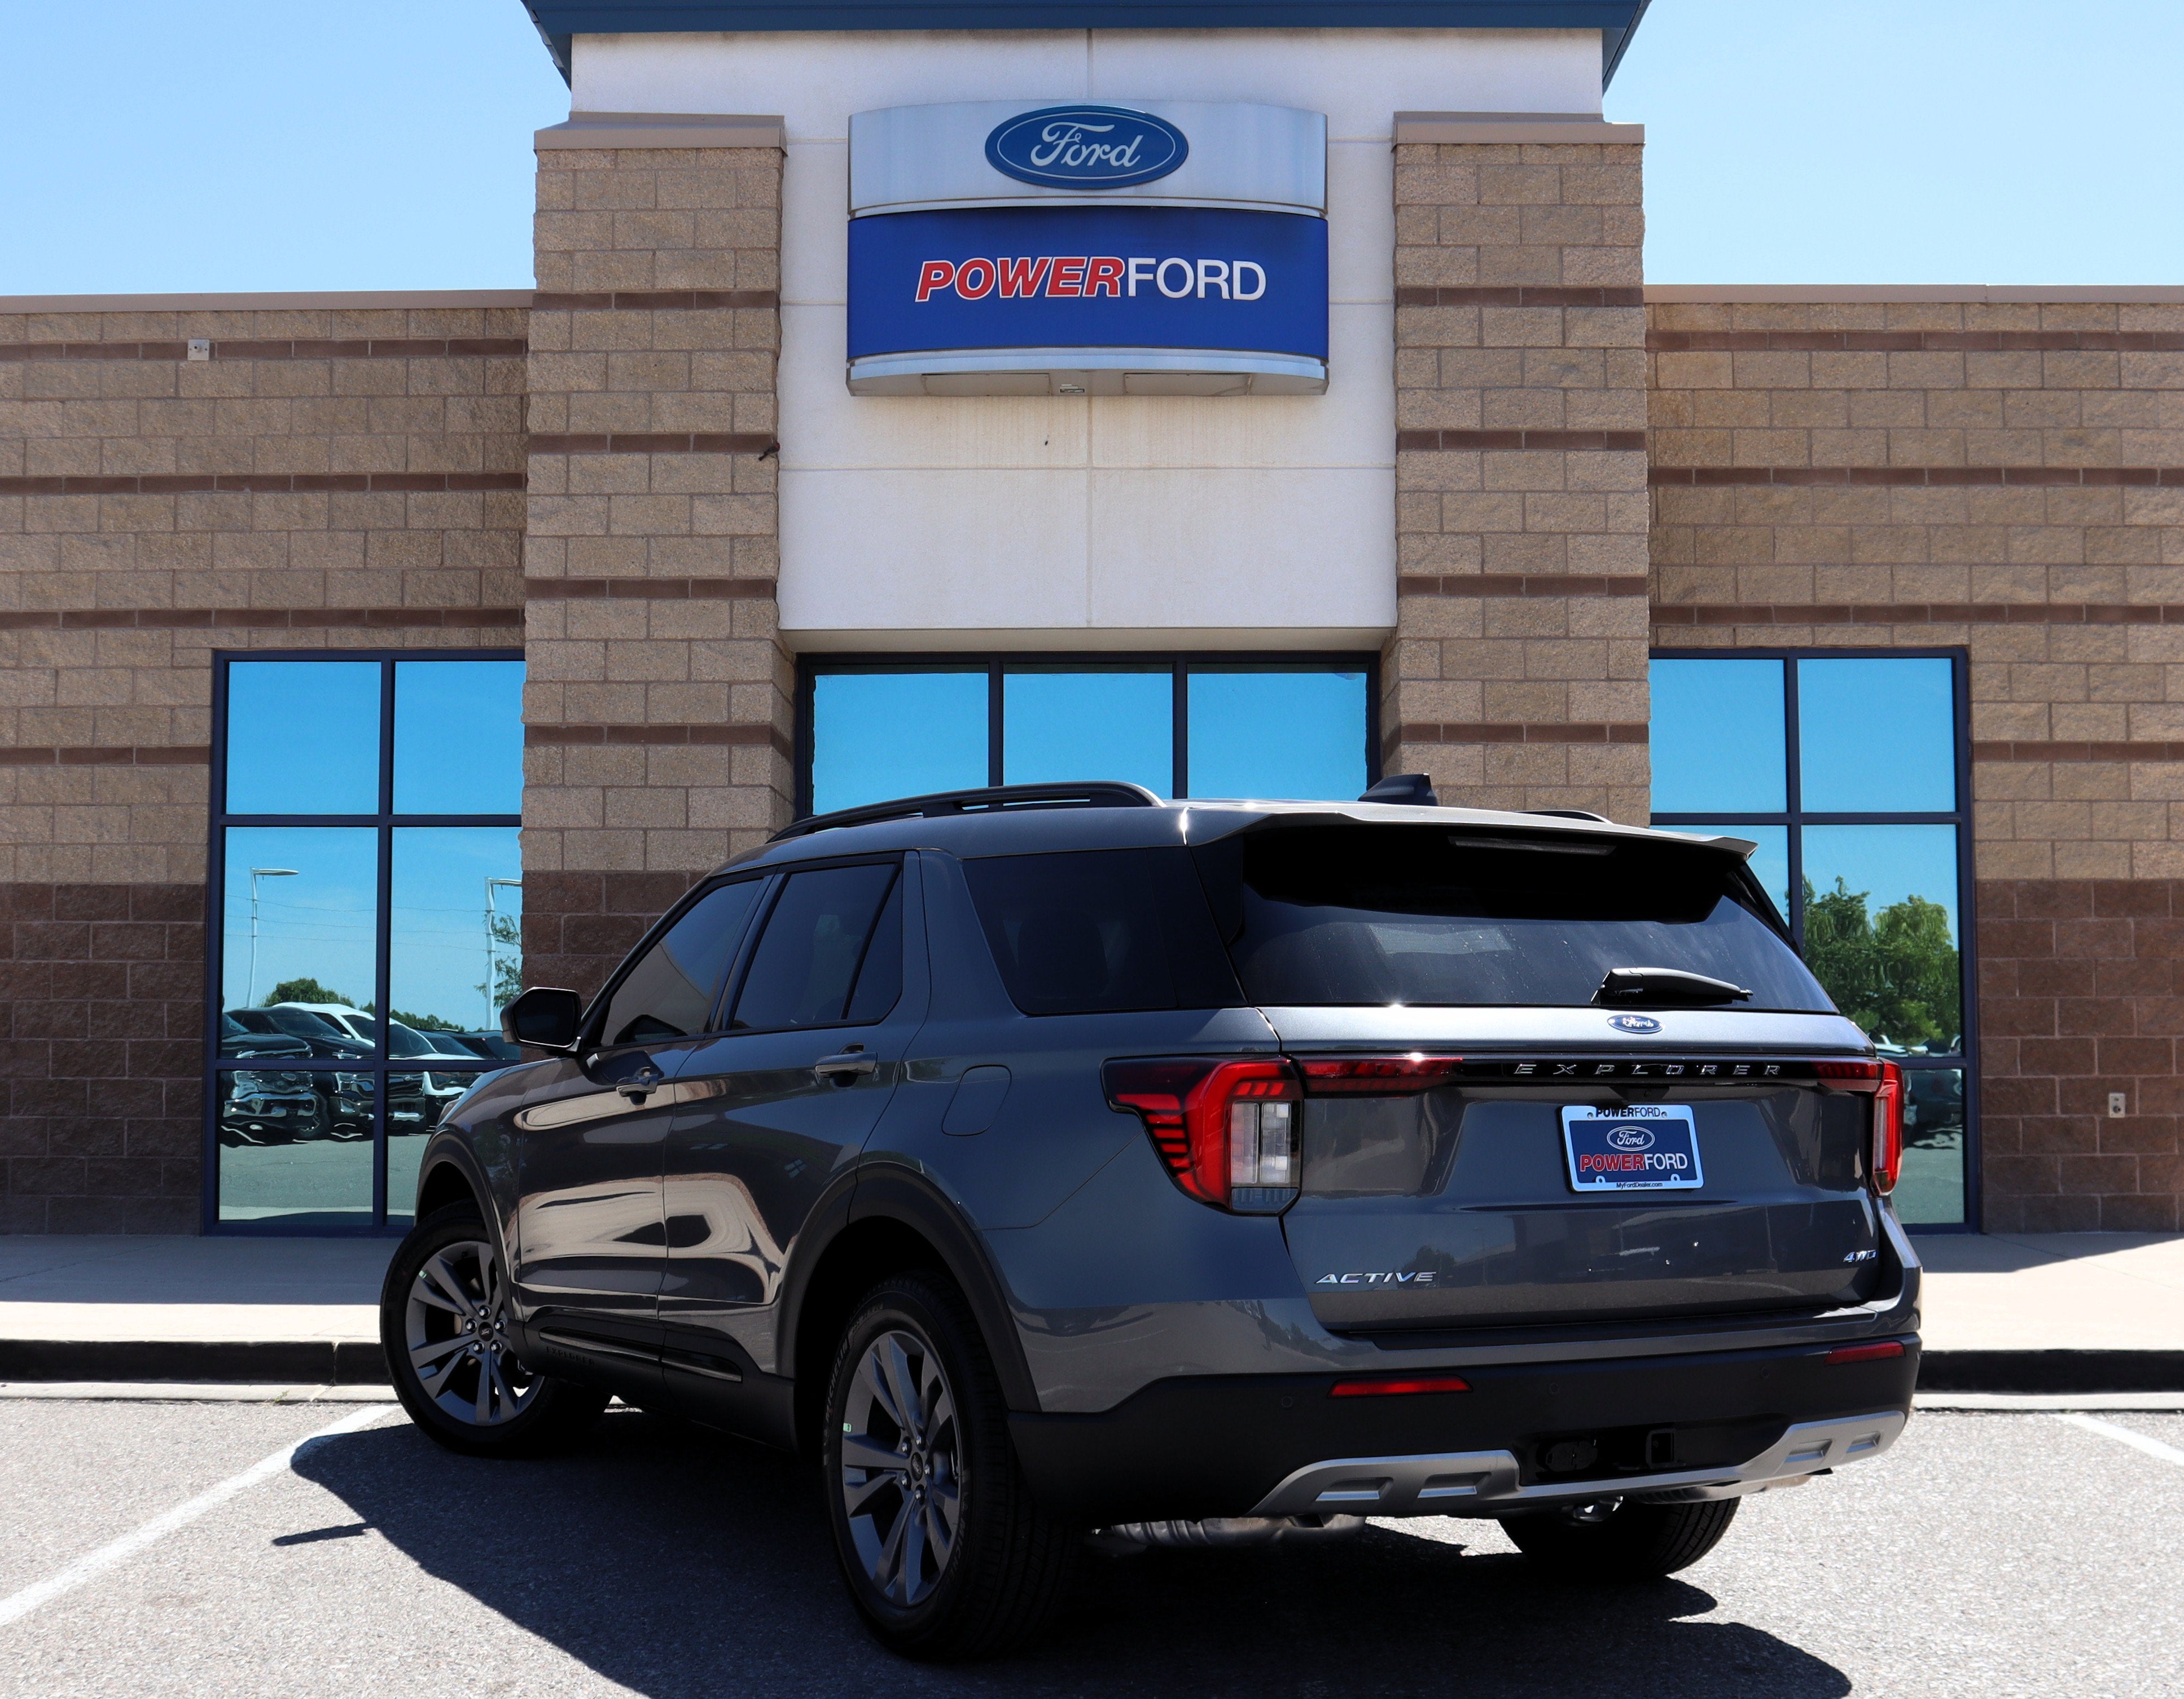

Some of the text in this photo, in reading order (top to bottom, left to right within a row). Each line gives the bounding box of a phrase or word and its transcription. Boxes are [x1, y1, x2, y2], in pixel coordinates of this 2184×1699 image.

[1031, 122, 1144, 167] Ford
[915, 257, 1266, 302] POWERFORD
[1514, 1064, 1781, 1075] EXPLORER
[1617, 1130, 1645, 1145] Ford
[1580, 1153, 1688, 1172] POWERFORD
[1616, 1181, 1663, 1190] MyFordDealer.com
[1842, 1249, 1876, 1263] 4WD
[1316, 1271, 1437, 1284] ACTIVE
